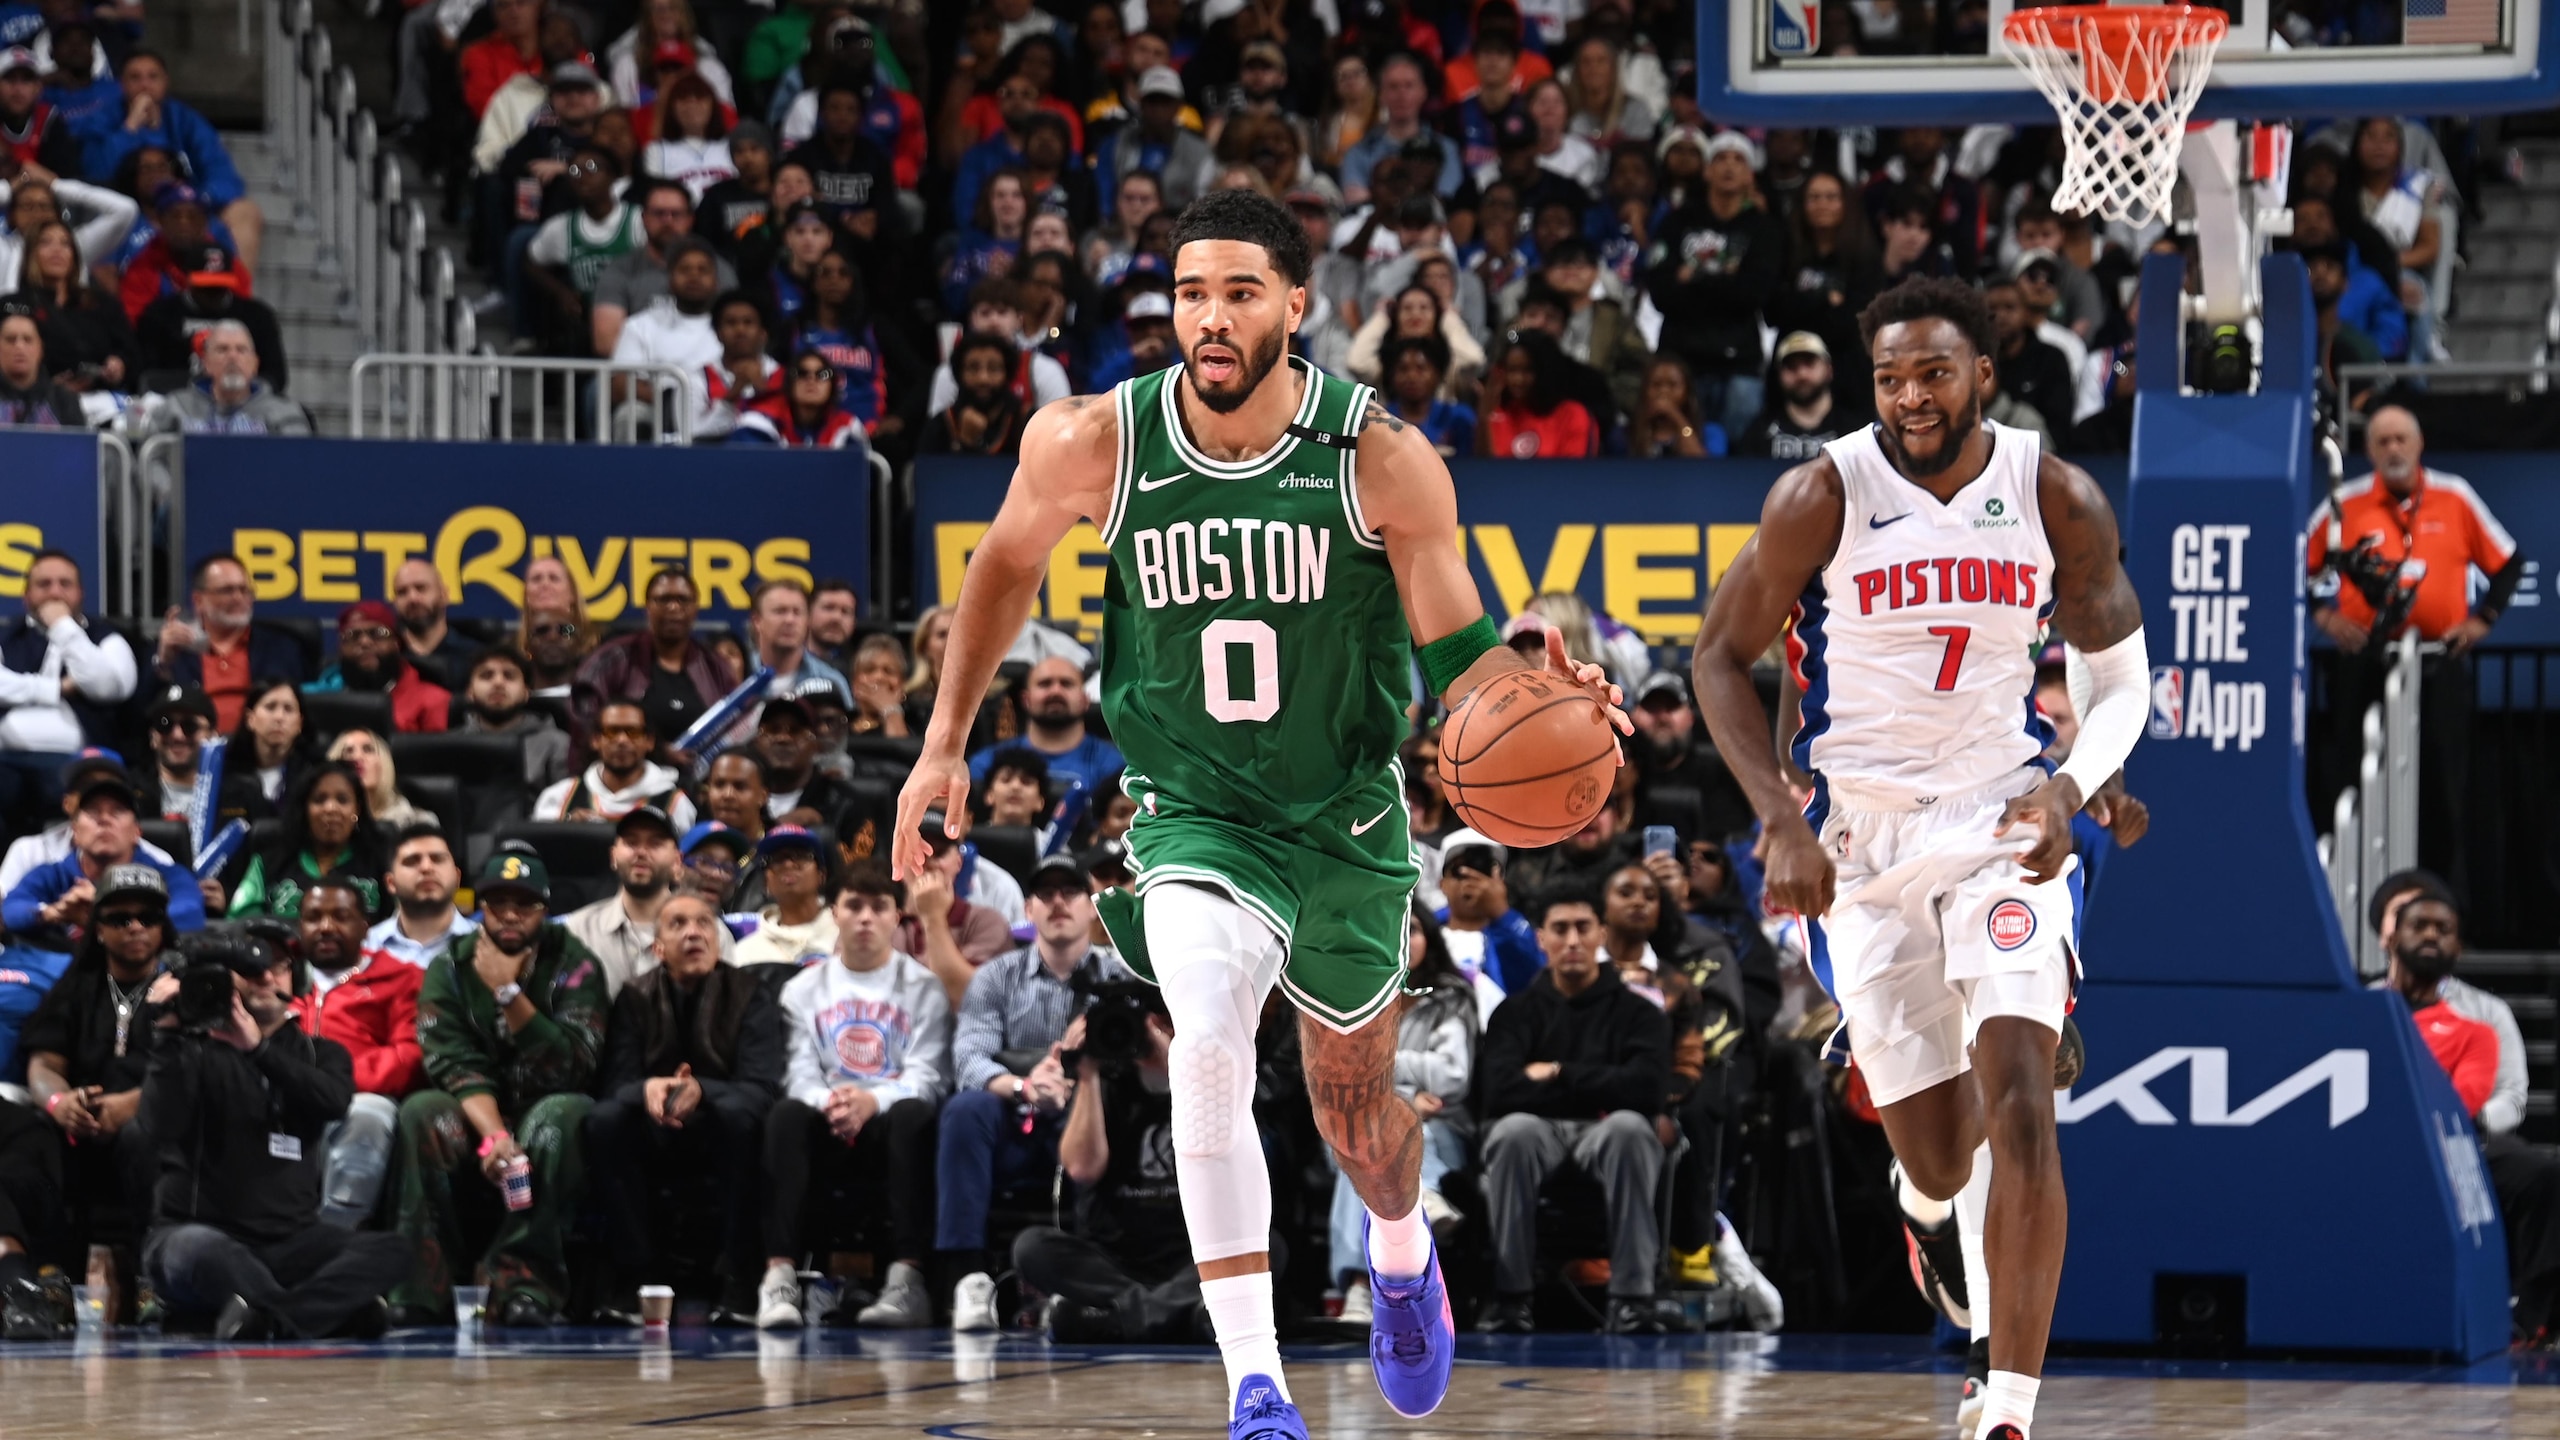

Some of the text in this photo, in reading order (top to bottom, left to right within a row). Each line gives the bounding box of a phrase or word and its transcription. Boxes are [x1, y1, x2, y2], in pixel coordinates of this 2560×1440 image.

[1316, 431, 1331, 444] 19
[1278, 471, 1334, 489] Amica
[1134, 518, 1330, 608] BOSTON
[1853, 557, 2038, 616] PISTONS
[2171, 523, 2251, 592] GET
[1928, 626, 1971, 691] 7
[2169, 595, 2250, 663] THE
[1201, 618, 1281, 723] 0
[2185, 667, 2267, 752] App
